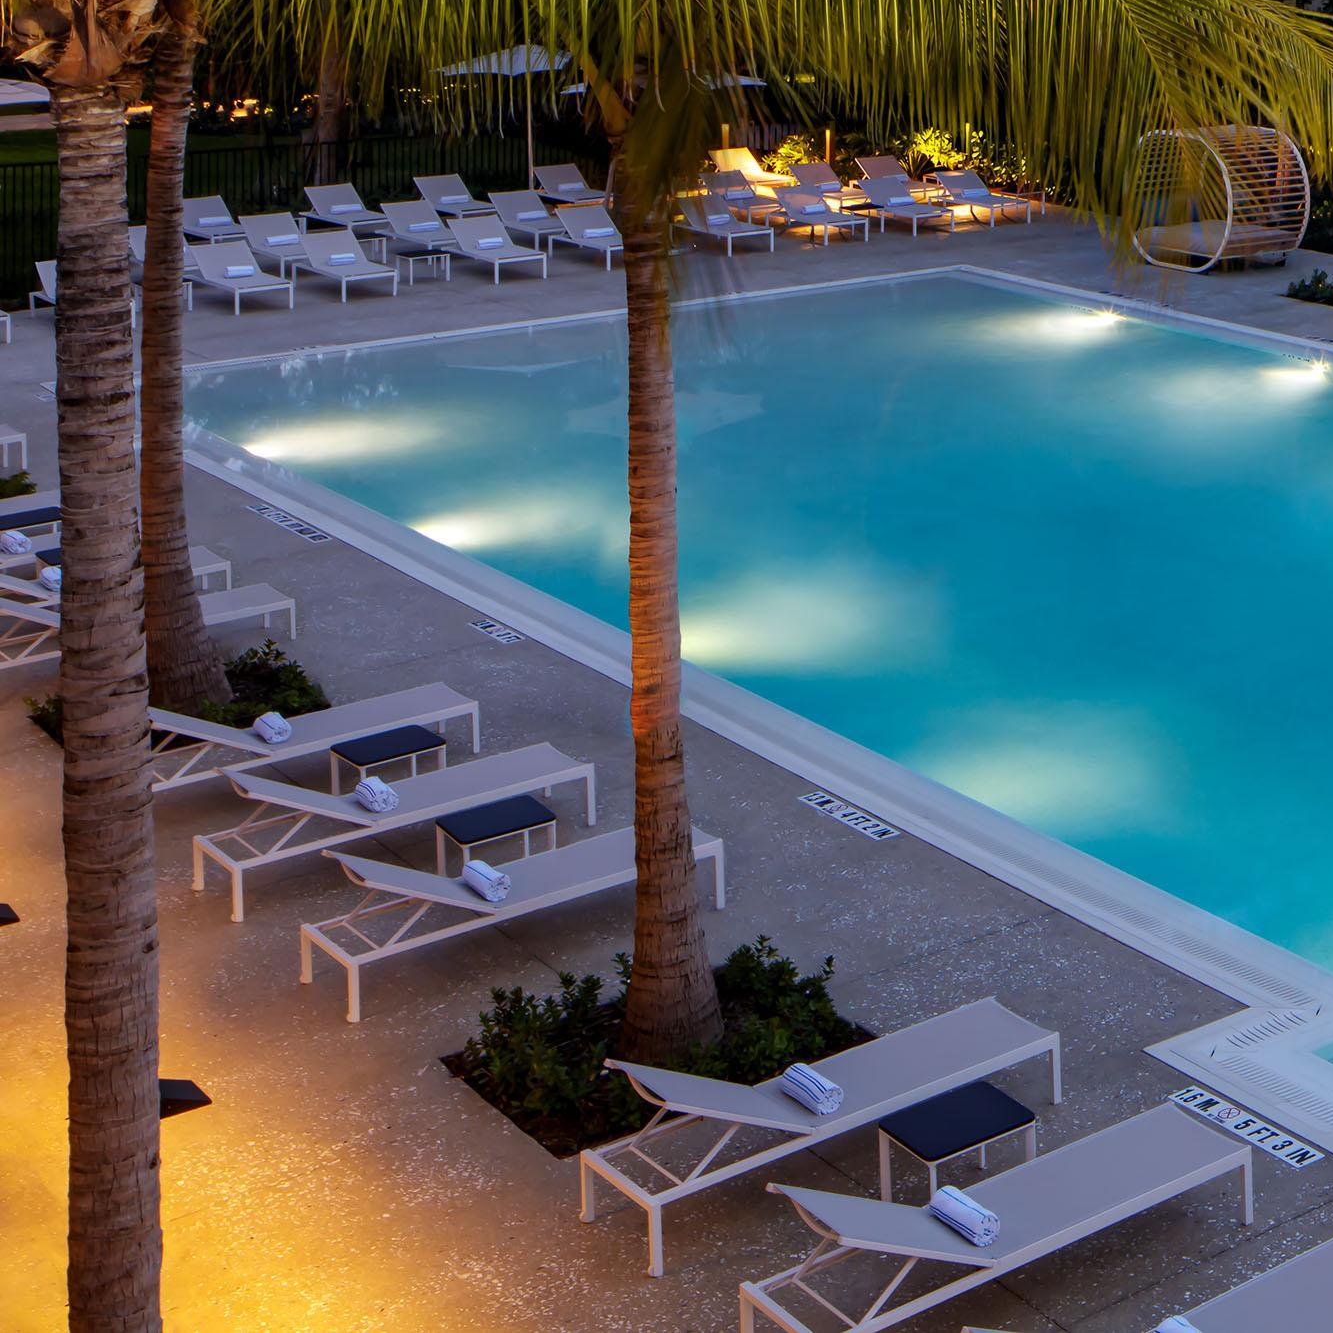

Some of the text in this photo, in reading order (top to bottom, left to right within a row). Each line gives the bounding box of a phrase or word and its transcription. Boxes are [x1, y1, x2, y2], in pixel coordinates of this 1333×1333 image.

[1174, 1088, 1205, 1103] 1.6
[1194, 1098, 1221, 1113] M.
[1233, 1118, 1257, 1130] 5
[1247, 1126, 1281, 1144] FT.
[1271, 1140, 1294, 1151] 3
[1284, 1147, 1317, 1166] IN.
